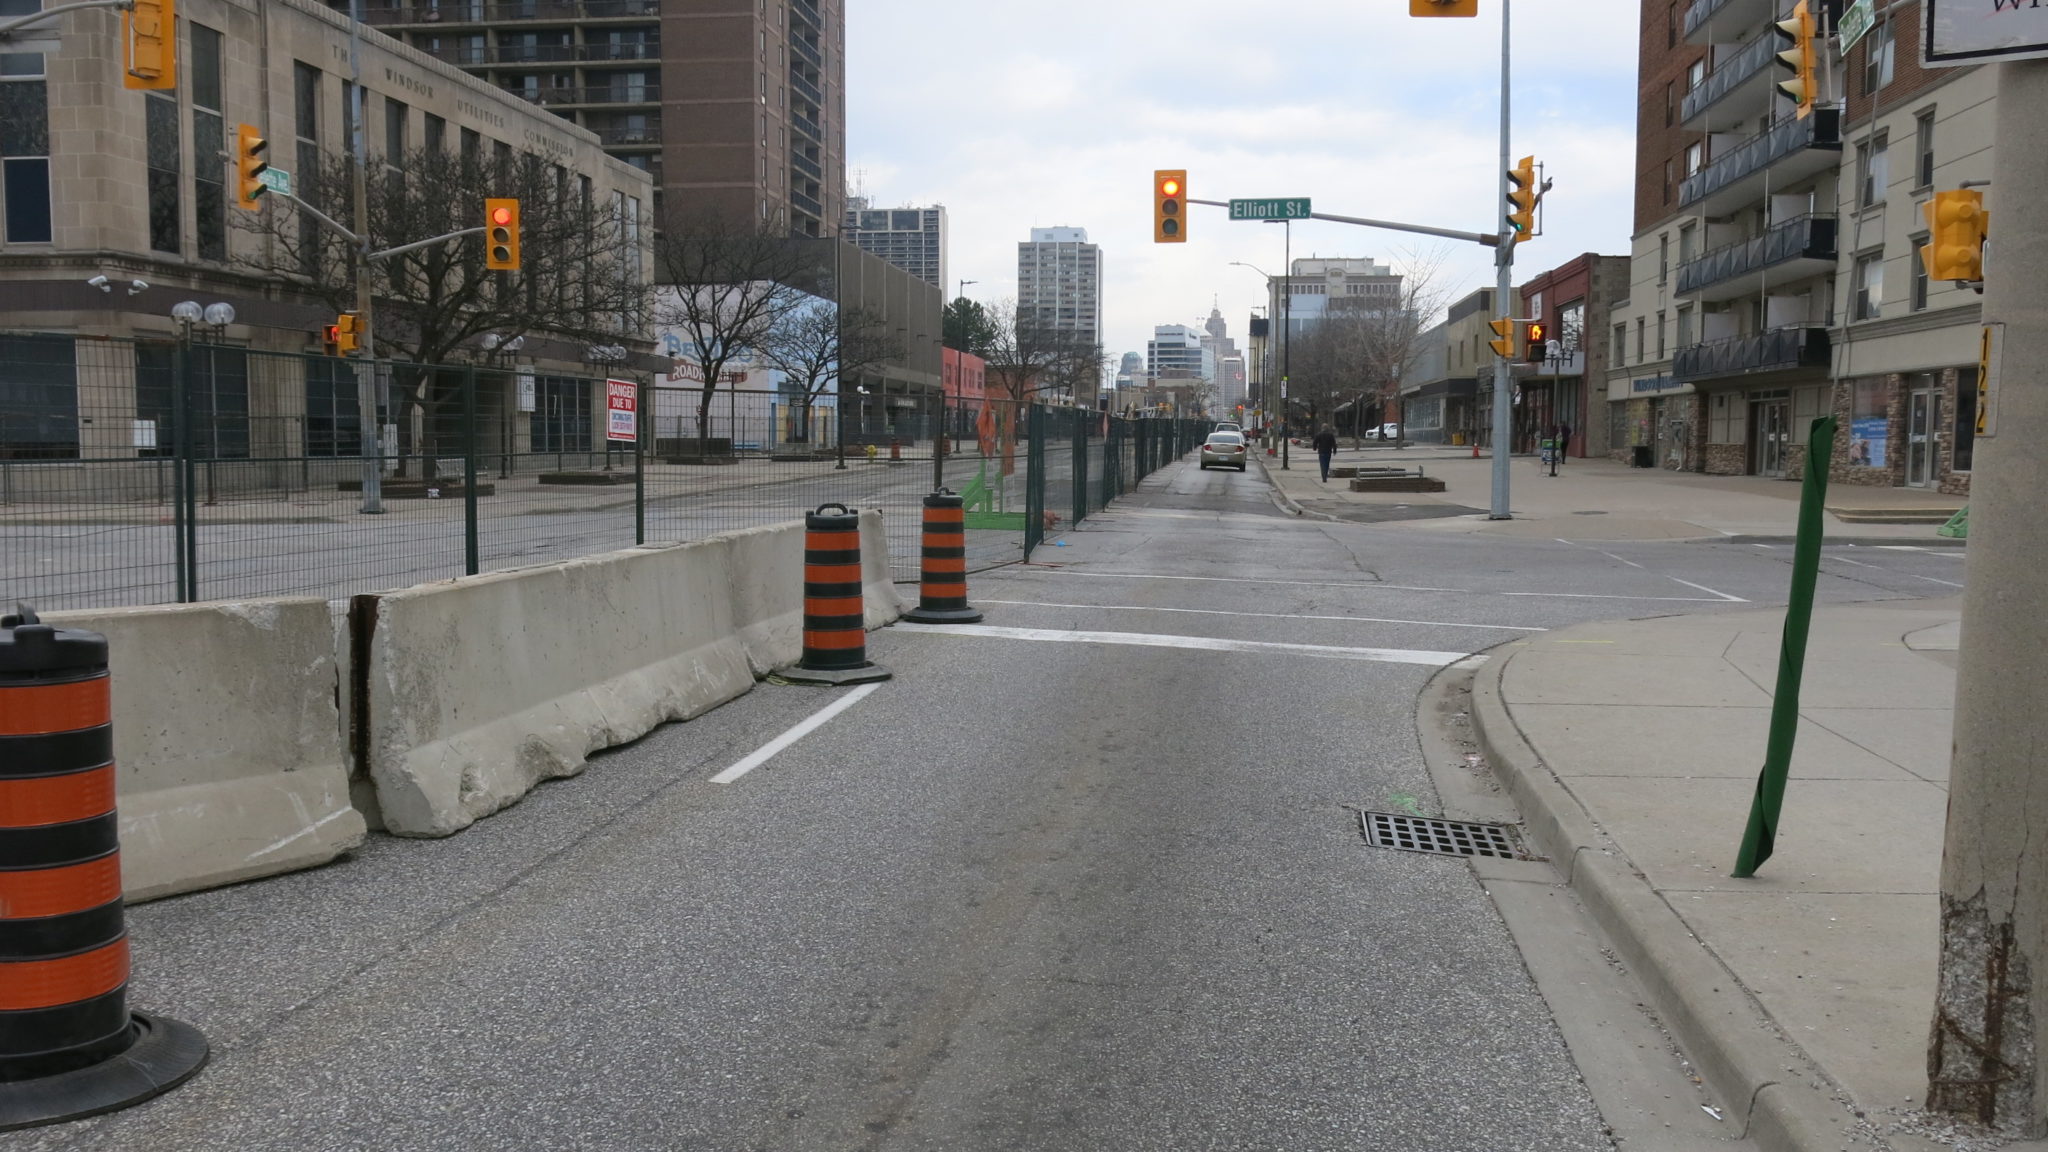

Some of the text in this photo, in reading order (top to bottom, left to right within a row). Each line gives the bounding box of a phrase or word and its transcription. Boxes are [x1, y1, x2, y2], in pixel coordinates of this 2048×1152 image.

[385, 68, 434, 99] WINDSOR
[457, 99, 505, 129] UTILITIES
[523, 128, 574, 158] COMMISSION
[1234, 201, 1306, 217] Elliott St.
[609, 383, 635, 399] DANGER
[612, 397, 632, 409] DUE TO
